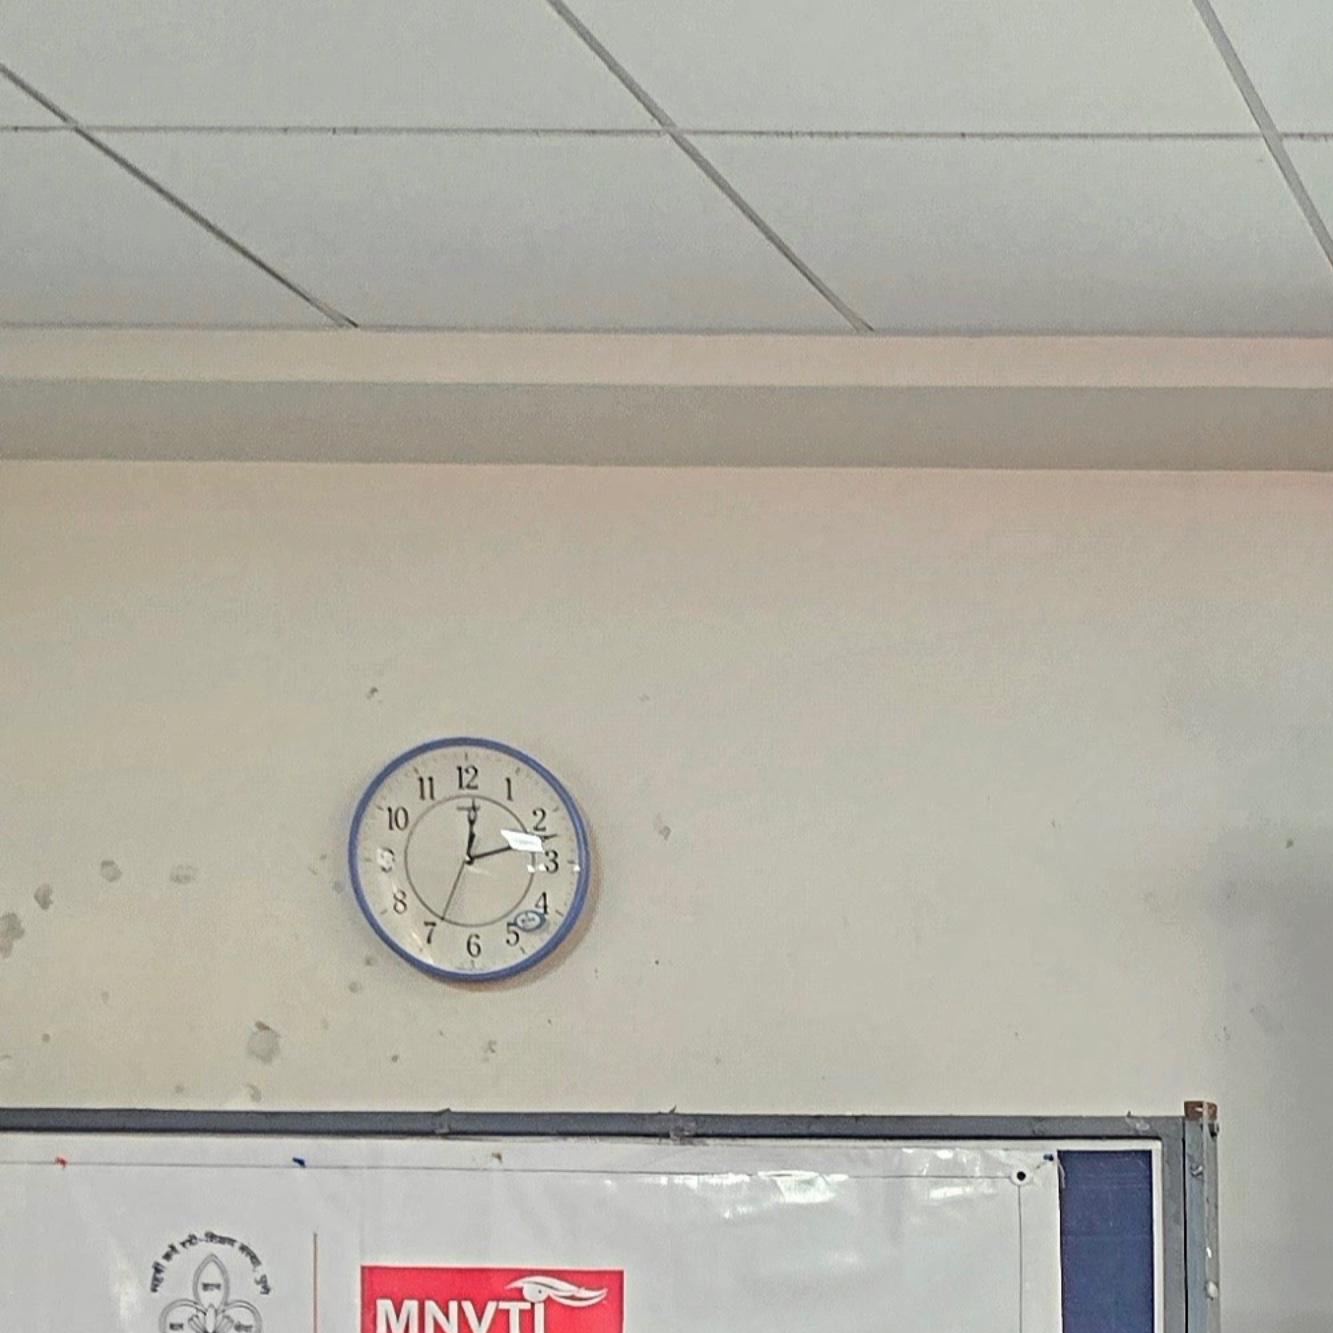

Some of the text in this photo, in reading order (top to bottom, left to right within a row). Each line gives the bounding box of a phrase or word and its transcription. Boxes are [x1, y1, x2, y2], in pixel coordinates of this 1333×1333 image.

[418, 776, 435, 800] 11
[457, 765, 479, 790] 12
[505, 777, 513, 801] 1
[387, 806, 409, 830] 10
[532, 808, 547, 832] 2
[376, 848, 396, 873] 9
[544, 850, 559, 874] 3
[393, 889, 408, 915] 8
[535, 892, 549, 916] 4
[423, 921, 437, 945] 7
[506, 922, 520, 947] 5
[466, 934, 482, 958] 6
